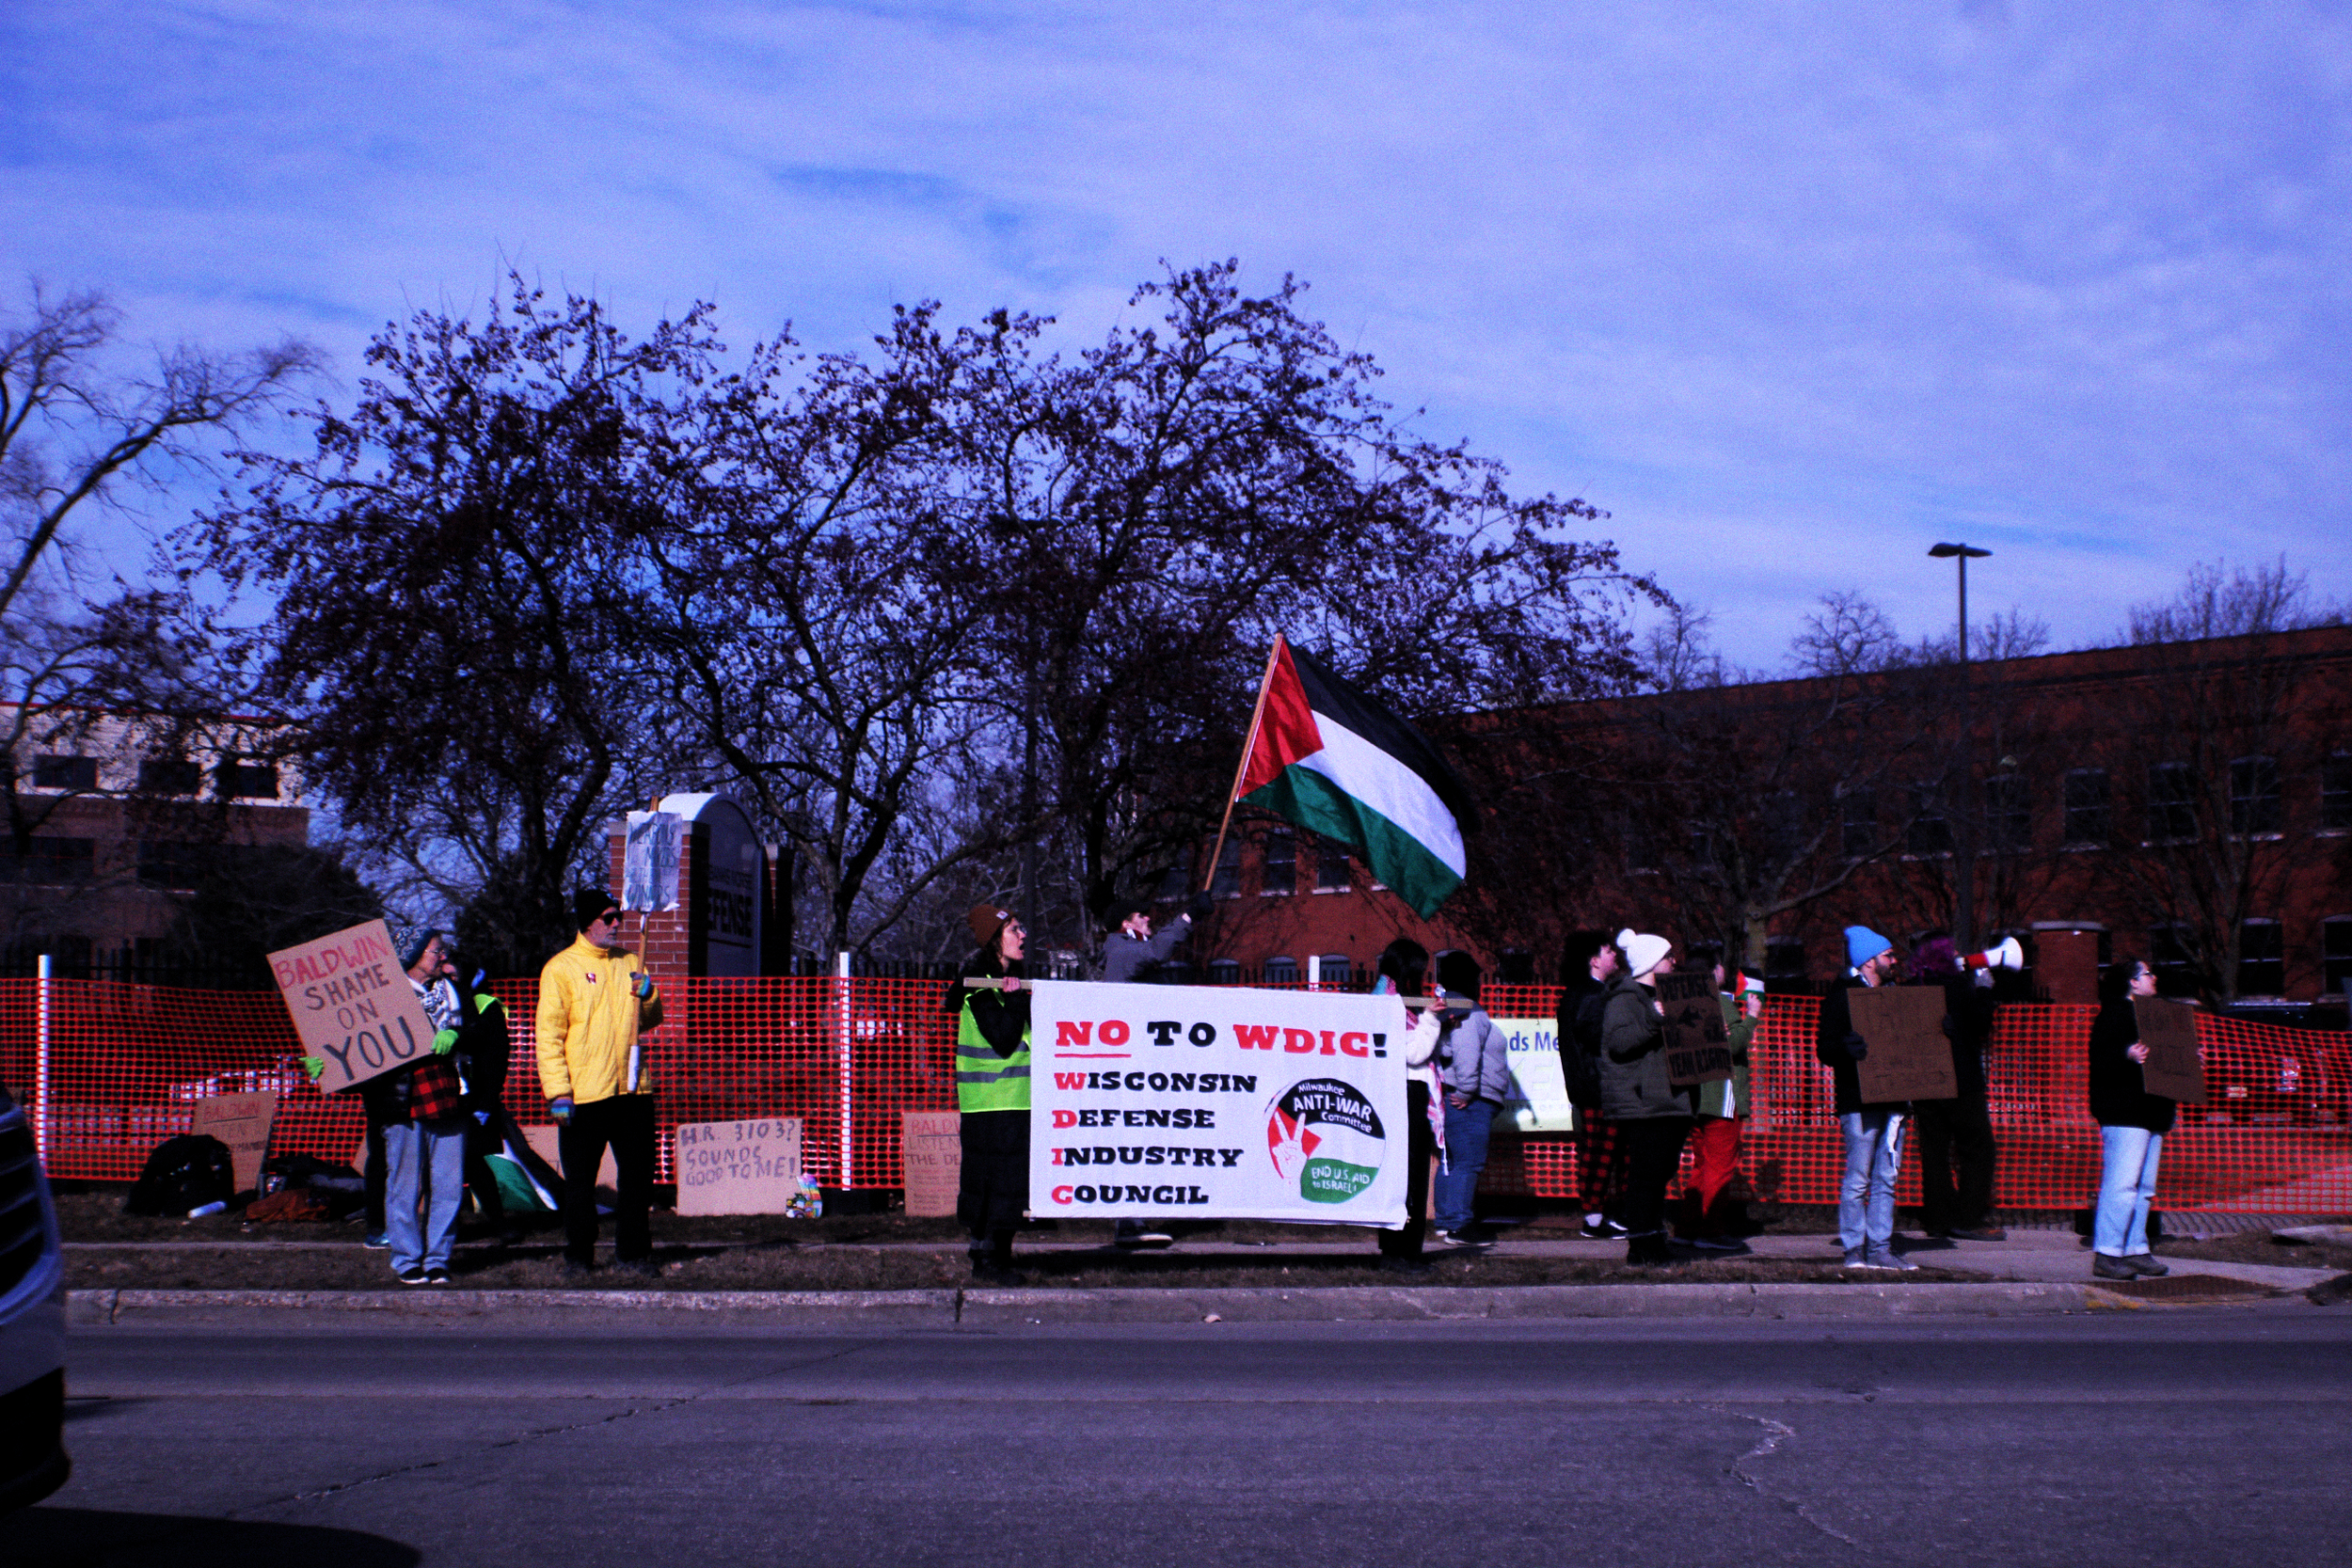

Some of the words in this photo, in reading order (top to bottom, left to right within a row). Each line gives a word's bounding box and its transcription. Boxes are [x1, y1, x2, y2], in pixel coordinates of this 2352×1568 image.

[708, 887, 752, 937] EFENSE
[275, 931, 389, 989] BALDWIN
[305, 963, 389, 1010] SHAME
[337, 998, 378, 1030] ON
[324, 1016, 415, 1081] YOU
[1056, 1020, 1131, 1046] NO
[1147, 1021, 1216, 1047] TO
[1232, 1024, 1387, 1057] WDIC!
[1054, 1071, 1257, 1093] WISCONSIN
[1298, 1082, 1345, 1097] Milwaukee
[1052, 1109, 1216, 1129] DEFENSE
[1294, 1094, 1373, 1122] ANTI-WAR
[1321, 1111, 1374, 1133] Committee
[686, 1146, 761, 1169] SOUNDS
[905, 1153, 937, 1165] THE
[1051, 1146, 1244, 1167] INDUSTRY
[686, 1167, 723, 1186] GOOD
[728, 1164, 752, 1180] TO
[755, 1157, 796, 1180] ME!
[1311, 1166, 1331, 1180] END
[1334, 1168, 1351, 1181] U.S.
[1352, 1173, 1371, 1185] AID
[1051, 1185, 1209, 1205] COUNCIL
[1312, 1180, 1321, 1188] to
